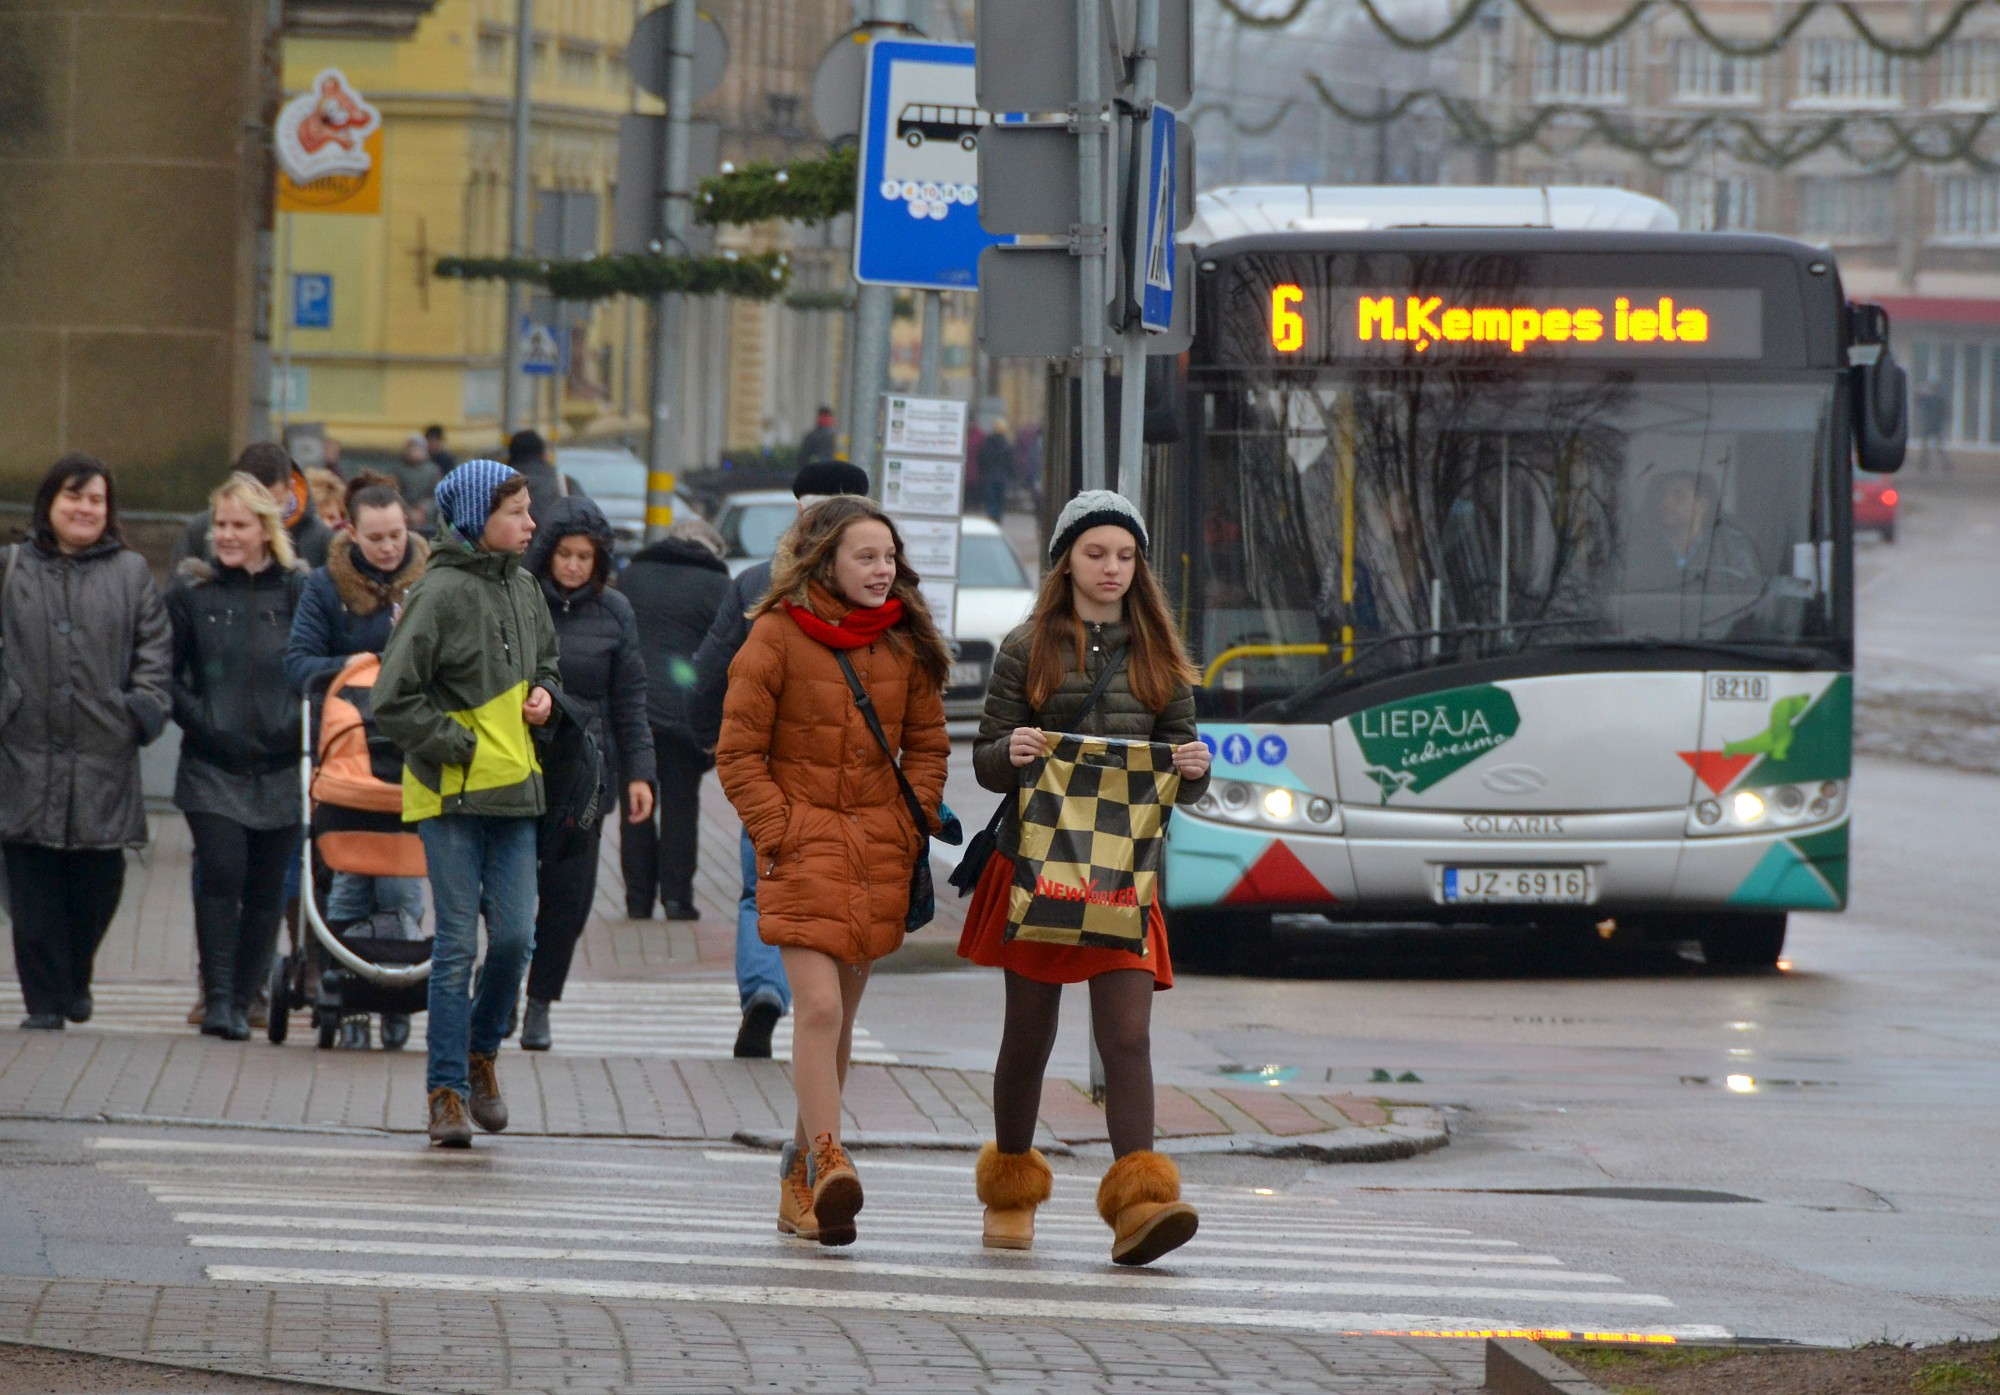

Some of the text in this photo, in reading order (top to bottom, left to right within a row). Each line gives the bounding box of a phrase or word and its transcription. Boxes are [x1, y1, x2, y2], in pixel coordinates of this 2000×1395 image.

[886, 184, 895, 195] 3
[923, 187, 937, 197] 10
[942, 188, 954, 198] 14
[961, 189, 973, 200] 15
[302, 279, 325, 310] P
[1271, 284, 1304, 352] 6
[1358, 295, 1708, 353] M.Ķempes iela
[1716, 678, 1763, 697] 8210
[1361, 705, 1491, 738] LIEPĀJA
[1400, 733, 1506, 767] iedvesma
[1462, 816, 1566, 834] SOLARIS
